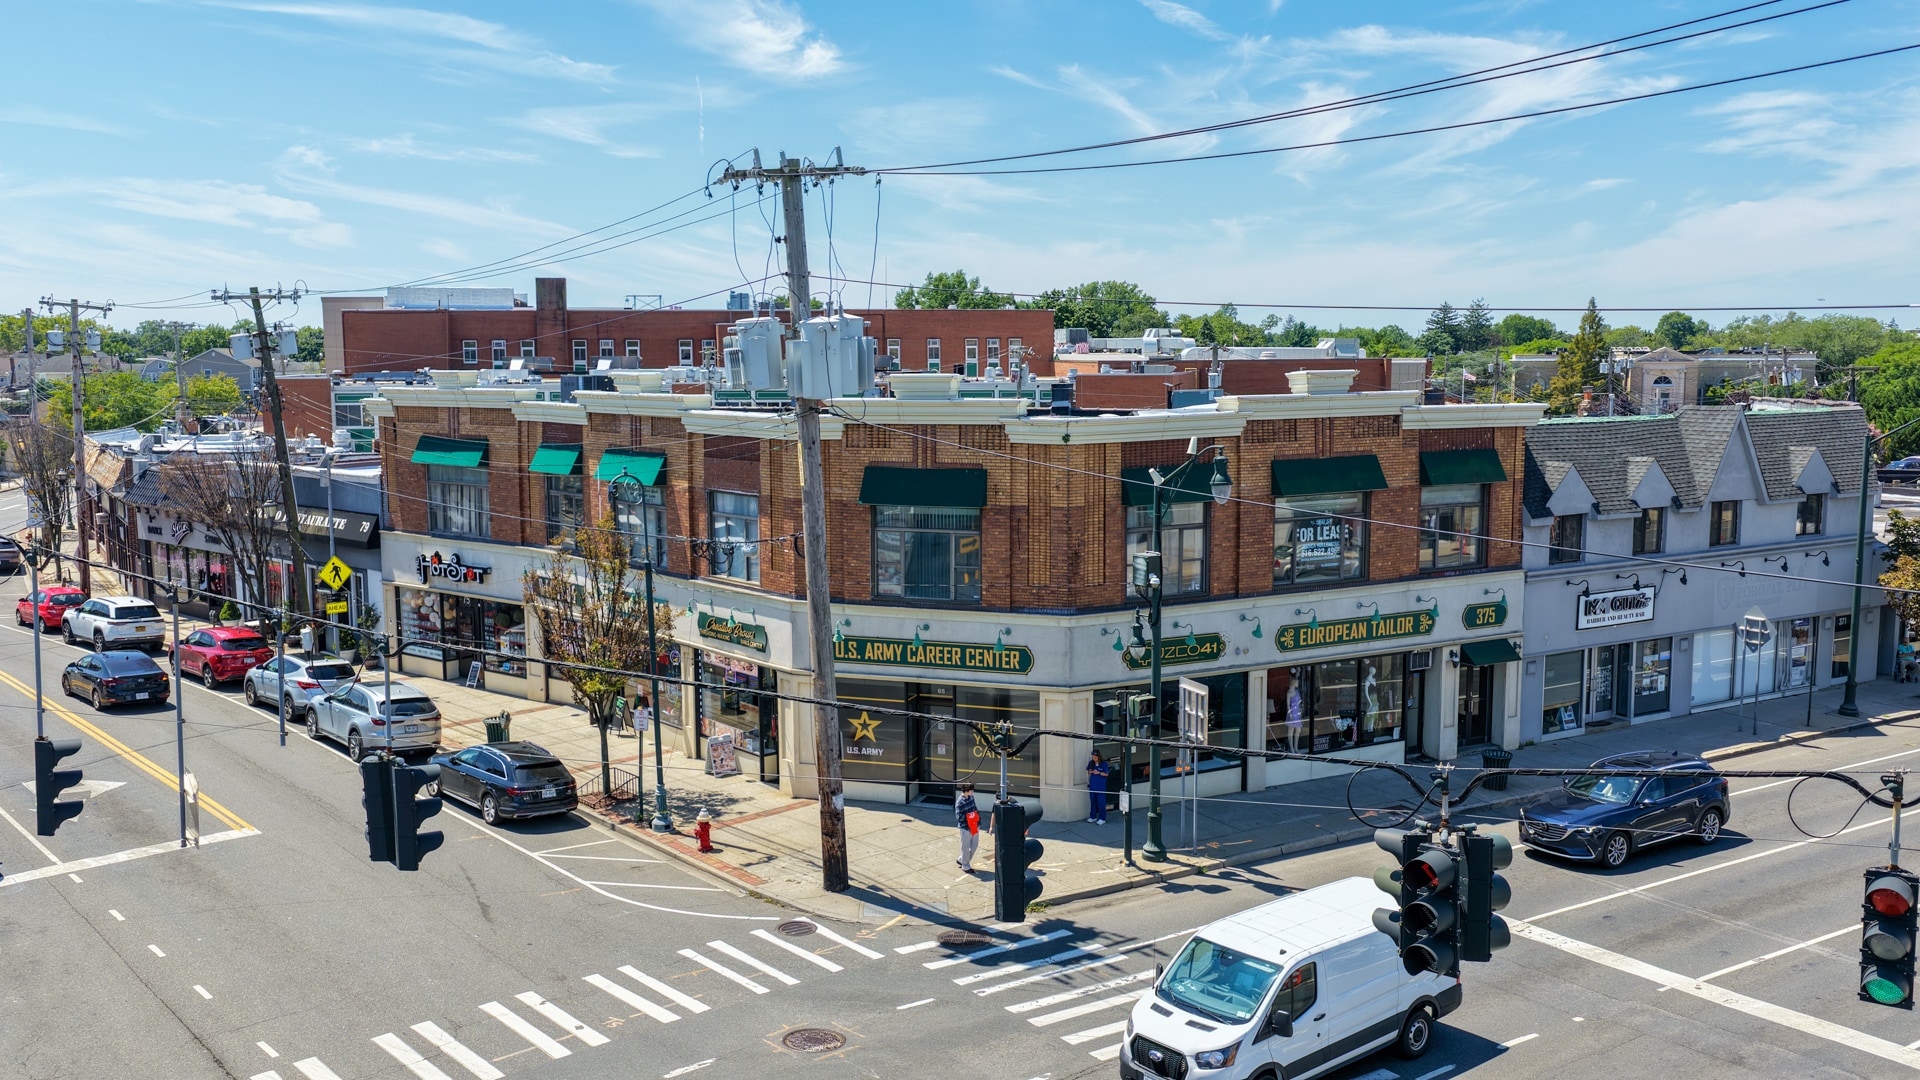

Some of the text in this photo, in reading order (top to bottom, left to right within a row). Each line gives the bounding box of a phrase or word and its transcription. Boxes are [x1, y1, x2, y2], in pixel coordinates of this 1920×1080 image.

[359, 521, 371, 533] 79
[1476, 607, 1496, 624] 375
[1607, 614, 1617, 622] AND
[1838, 617, 1847, 626] 371
[1299, 615, 1414, 646] EUROPEAN TAILOR
[835, 640, 1020, 670] U.S. ARMY CAREER CENTER
[846, 746, 884, 757] U.S. ARMY
